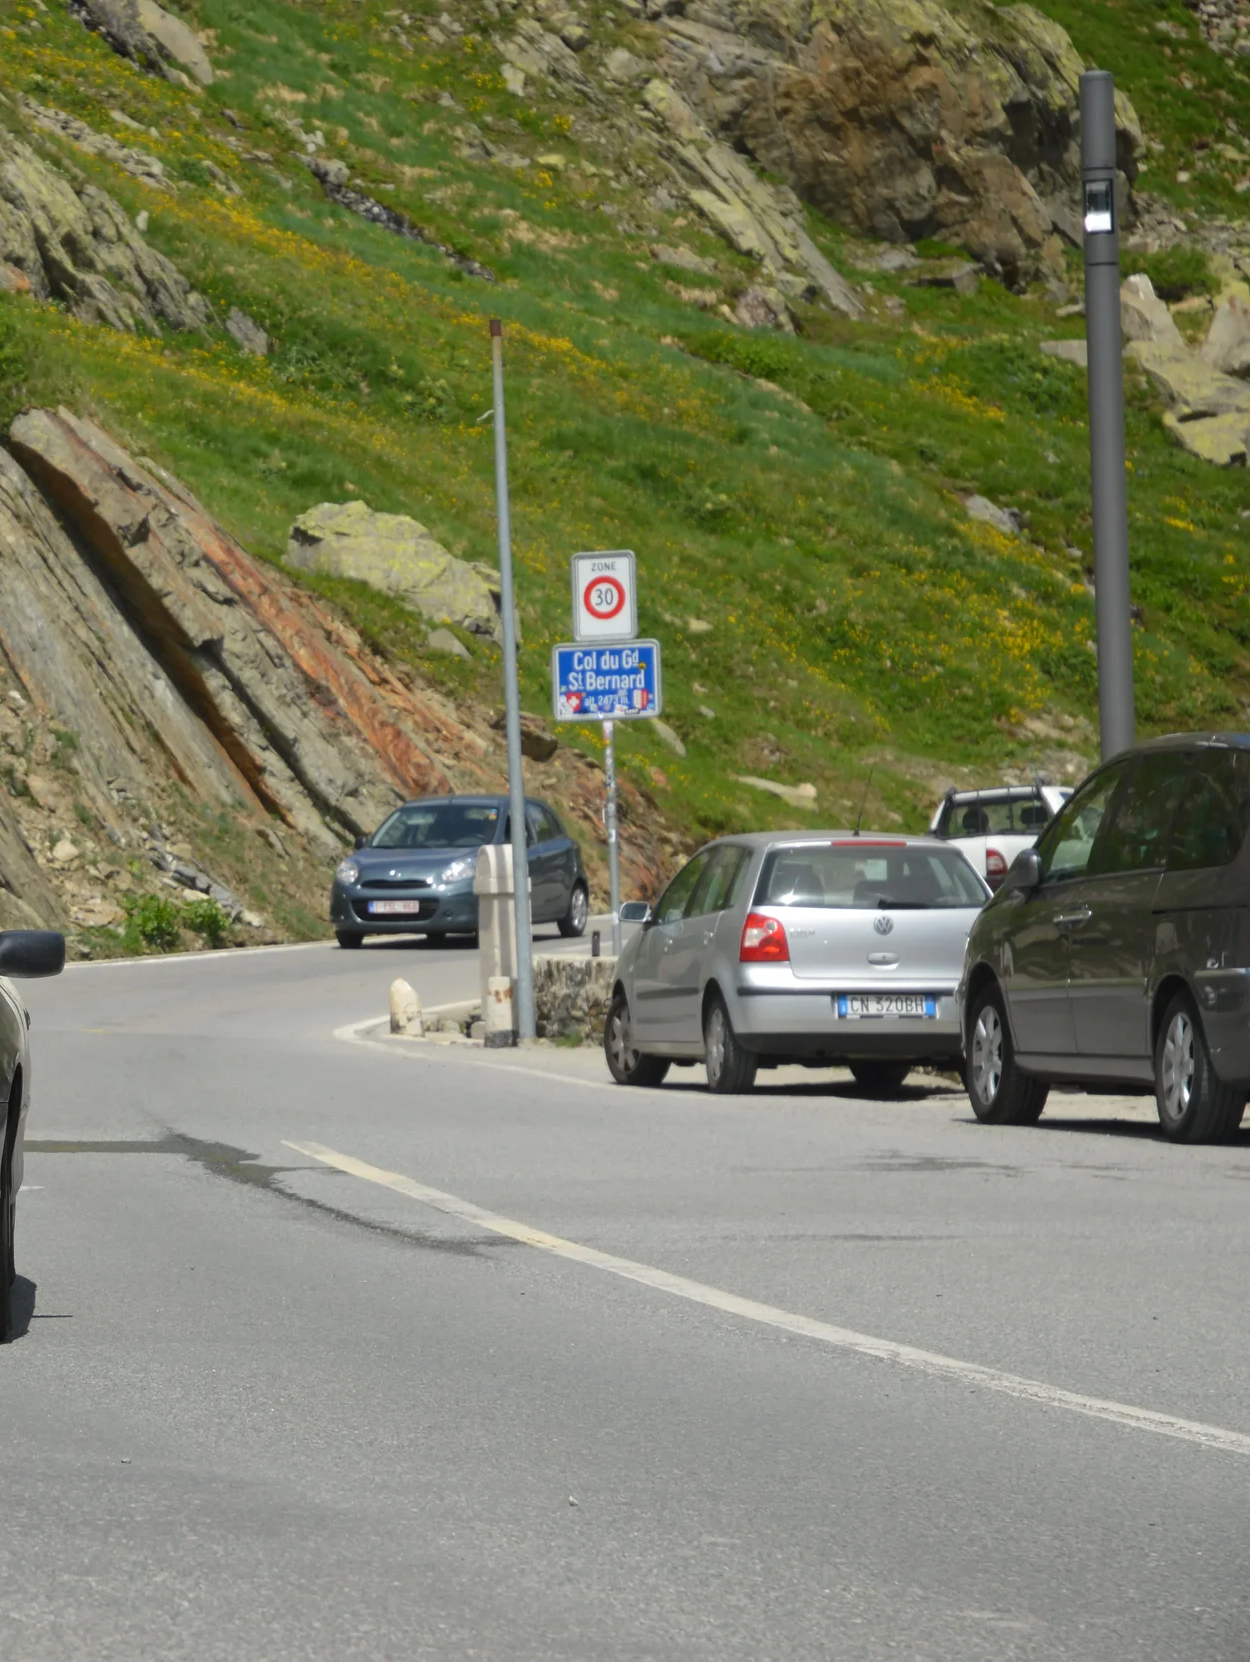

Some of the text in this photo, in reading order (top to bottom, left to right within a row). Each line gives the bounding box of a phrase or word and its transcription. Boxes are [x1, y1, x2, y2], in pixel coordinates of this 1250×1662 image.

[591, 561, 617, 572] ZONE
[595, 588, 614, 606] 30
[574, 649, 639, 670] Col du Gd
[568, 669, 645, 691] St Bernard
[850, 996, 924, 1012] CN 320BH
